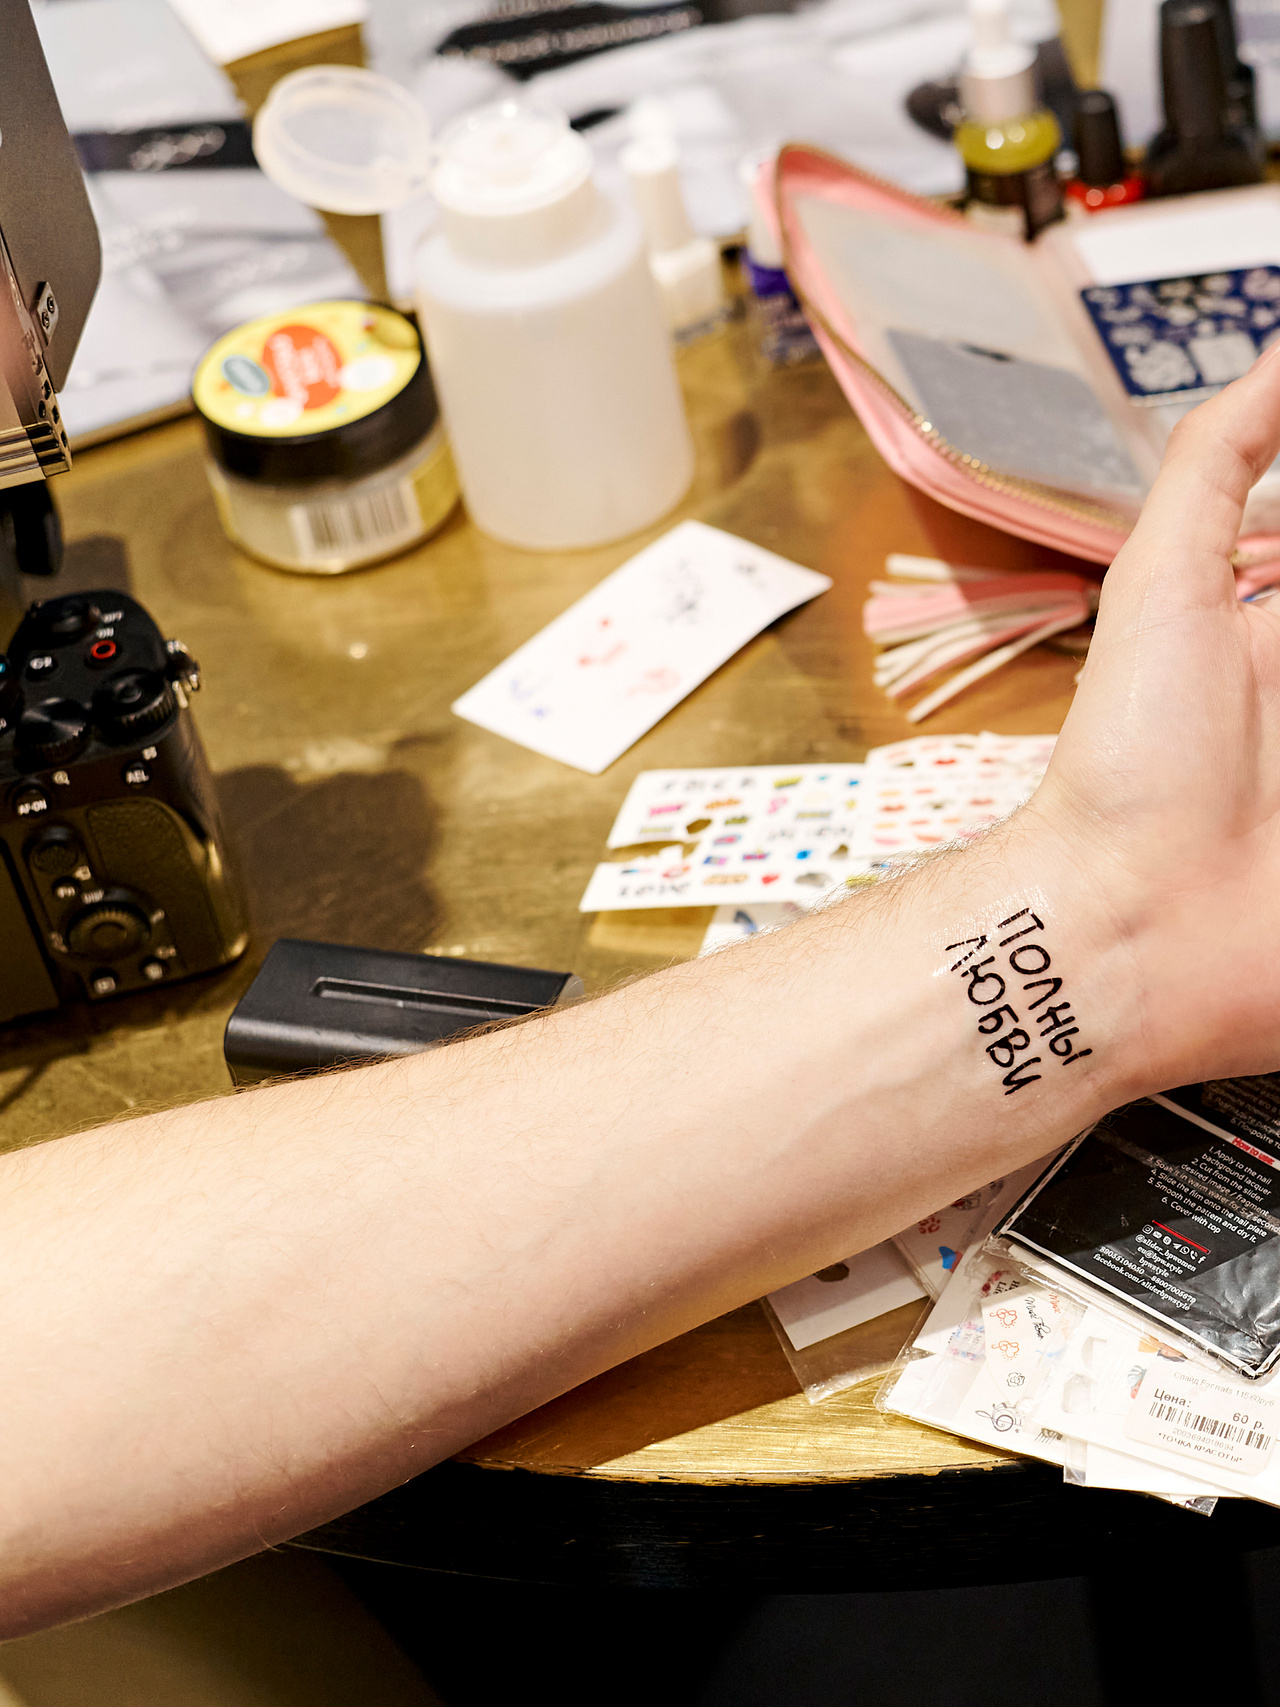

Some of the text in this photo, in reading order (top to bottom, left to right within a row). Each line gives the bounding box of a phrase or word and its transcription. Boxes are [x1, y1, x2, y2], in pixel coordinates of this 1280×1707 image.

[17, 797, 48, 817] AF-ON
[997, 907, 1093, 1066] ПОЛНЫ
[945, 934, 1042, 1096] ЛЮБВИ
[1243, 1122, 1274, 1144] Покройте
[1199, 1162, 1213, 1174] Cut
[1212, 1169, 1230, 1183] from
[1230, 1180, 1243, 1191] the
[1242, 1188, 1264, 1202] slider
[1213, 1149, 1236, 1165] Apply
[1235, 1161, 1244, 1169] to
[1244, 1166, 1257, 1177] the
[1256, 1174, 1272, 1185] nail
[1244, 1176, 1272, 1196] lacquer
[1158, 1172, 1177, 1186] Slide
[1176, 1182, 1190, 1193] the
[1189, 1189, 1204, 1201] film
[1203, 1198, 1221, 1211] onto
[1221, 1208, 1234, 1219] the
[1233, 1216, 1249, 1227] nail
[1246, 1224, 1267, 1237] plate
[1181, 1164, 1209, 1182] desired
[1206, 1178, 1231, 1196] image
[1235, 1194, 1270, 1218] fragment
[1188, 1178, 1209, 1192] warm
[1208, 1190, 1230, 1204] water
[1228, 1200, 1240, 1211] for
[1239, 1207, 1254, 1219] 5-7
[1154, 1181, 1184, 1201] Smooth
[1183, 1197, 1196, 1208] the
[1195, 1205, 1223, 1224] pattern
[1221, 1220, 1238, 1232] and
[1236, 1229, 1250, 1239] dry
[1249, 1234, 1257, 1243] it.
[1170, 1201, 1193, 1216] Cover
[1191, 1215, 1208, 1226] with
[1207, 1223, 1221, 1234] top
[1135, 1234, 1197, 1272] @slider_bpwomen
[1136, 1255, 1171, 1279] bpwstyle
[1092, 1253, 1192, 1312] facebook.com/sliderbpwstyle
[1154, 1388, 1264, 1430] Цена: 60 р.
